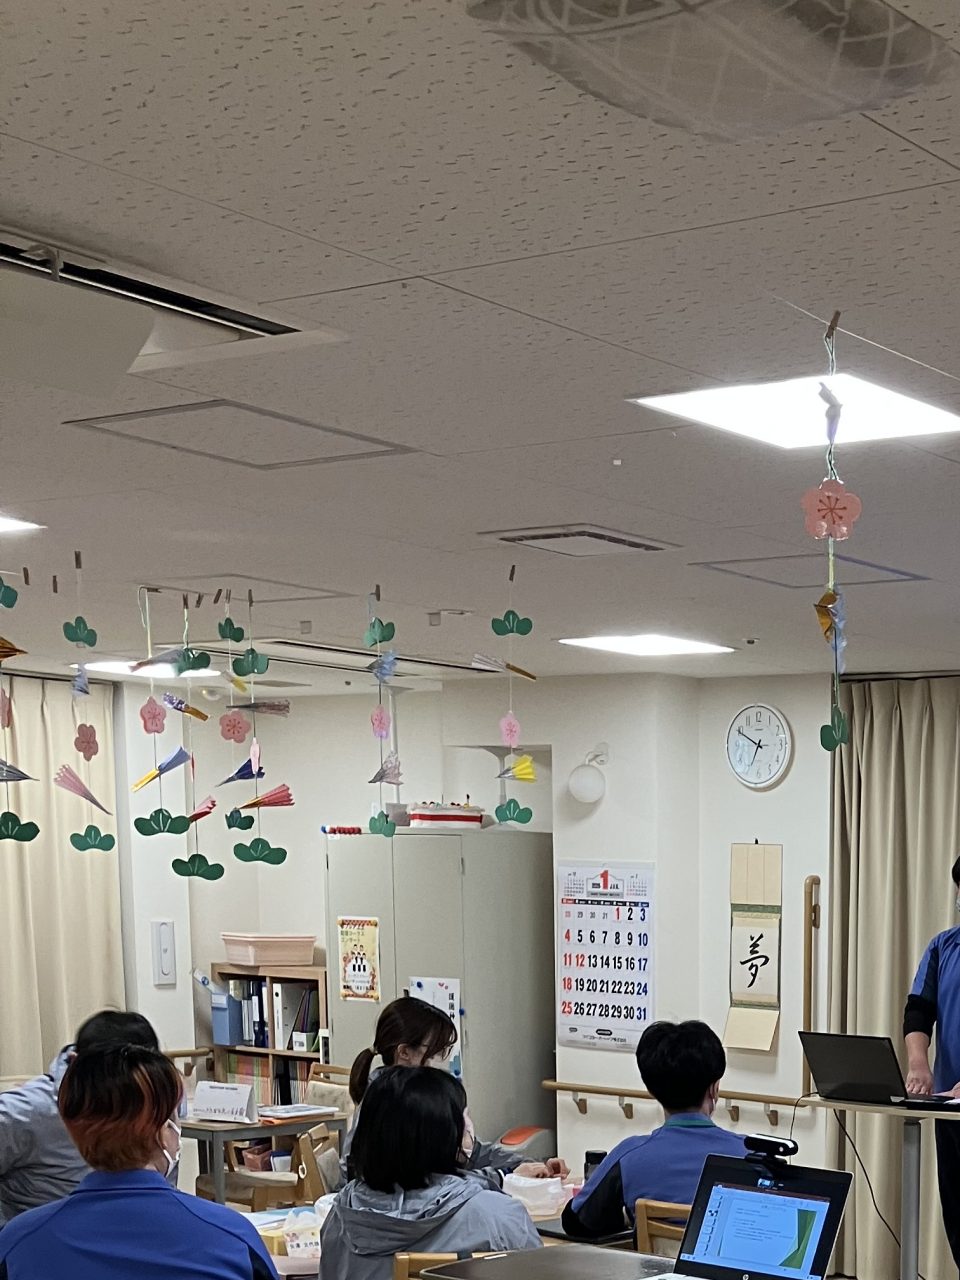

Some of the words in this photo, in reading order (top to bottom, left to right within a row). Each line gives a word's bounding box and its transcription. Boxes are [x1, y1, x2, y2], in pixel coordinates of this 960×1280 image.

[600, 869, 608, 890] 1
[638, 933, 648, 946] 10
[564, 953, 571, 966] 11
[576, 954, 585, 967] 12
[588, 955, 597, 968] 13
[600, 955, 610, 968] 14
[613, 956, 622, 969] 15
[625, 957, 635, 970] 16
[638, 958, 648, 971] 17
[563, 977, 572, 990] 18
[575, 978, 584, 991] 19
[587, 979, 597, 992] 20
[600, 980, 609, 993] 21
[611, 981, 622, 993] 22
[624, 982, 634, 994] 23
[636, 983, 648, 995] 24
[562, 1001, 572, 1014] 25
[574, 1002, 584, 1015] 26
[586, 1003, 597, 1016] 27
[599, 1004, 609, 1017] 28
[611, 1005, 622, 1018] 29
[624, 1006, 634, 1019] 30
[637, 1007, 646, 1020] 31
